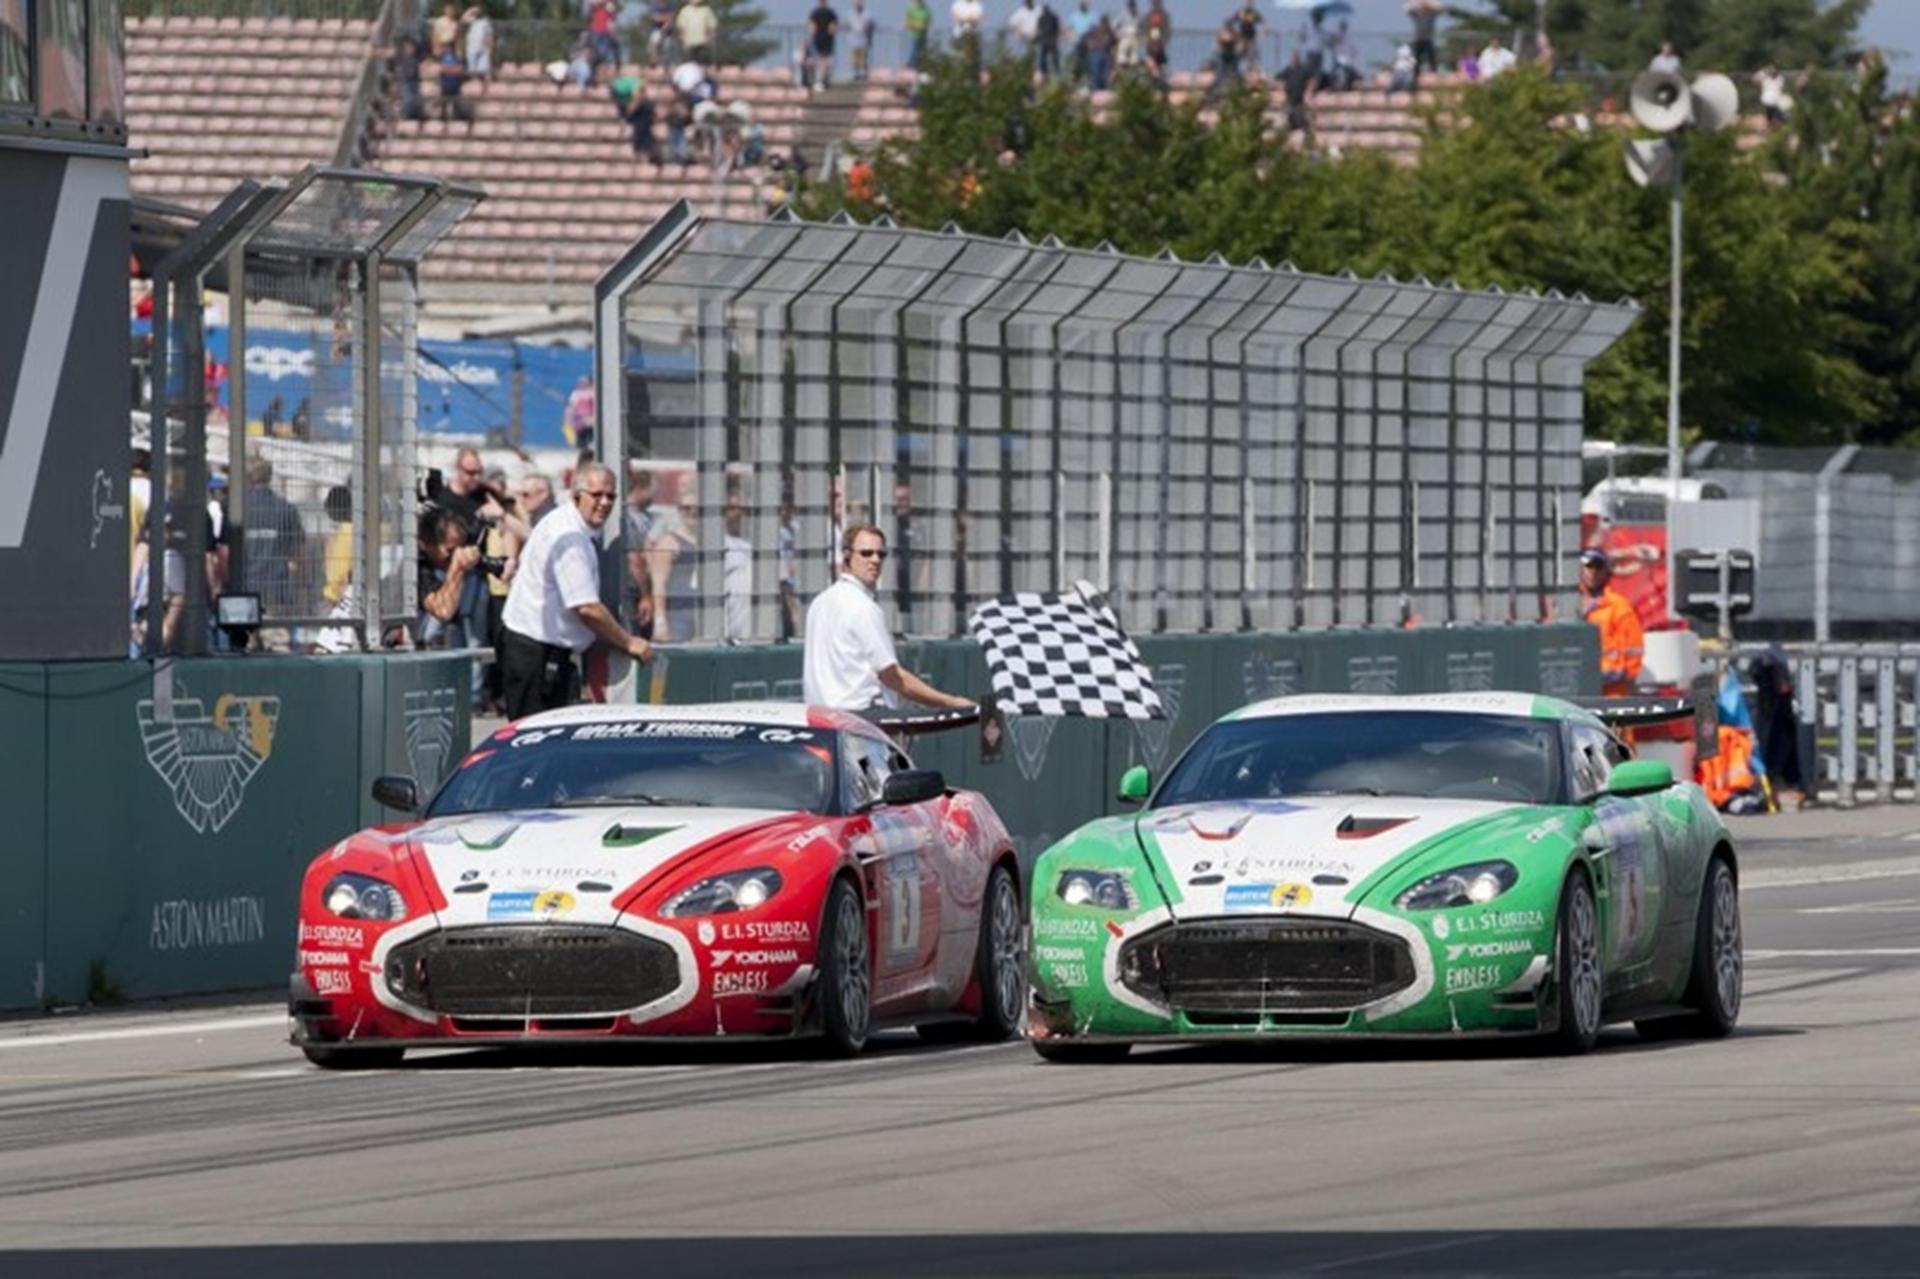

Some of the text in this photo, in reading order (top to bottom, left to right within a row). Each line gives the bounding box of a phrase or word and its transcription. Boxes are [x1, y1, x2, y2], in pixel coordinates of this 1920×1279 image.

[151, 896, 265, 949] ASTON MARTIN
[722, 920, 810, 940] E.I. STURDZA
[1480, 910, 1545, 931] STURDZA
[735, 949, 798, 965] YOKOHAMA
[1468, 939, 1532, 957] YOKOHAMA
[714, 970, 768, 994] ENDLESS
[1446, 965, 1501, 990] ENDLESS
